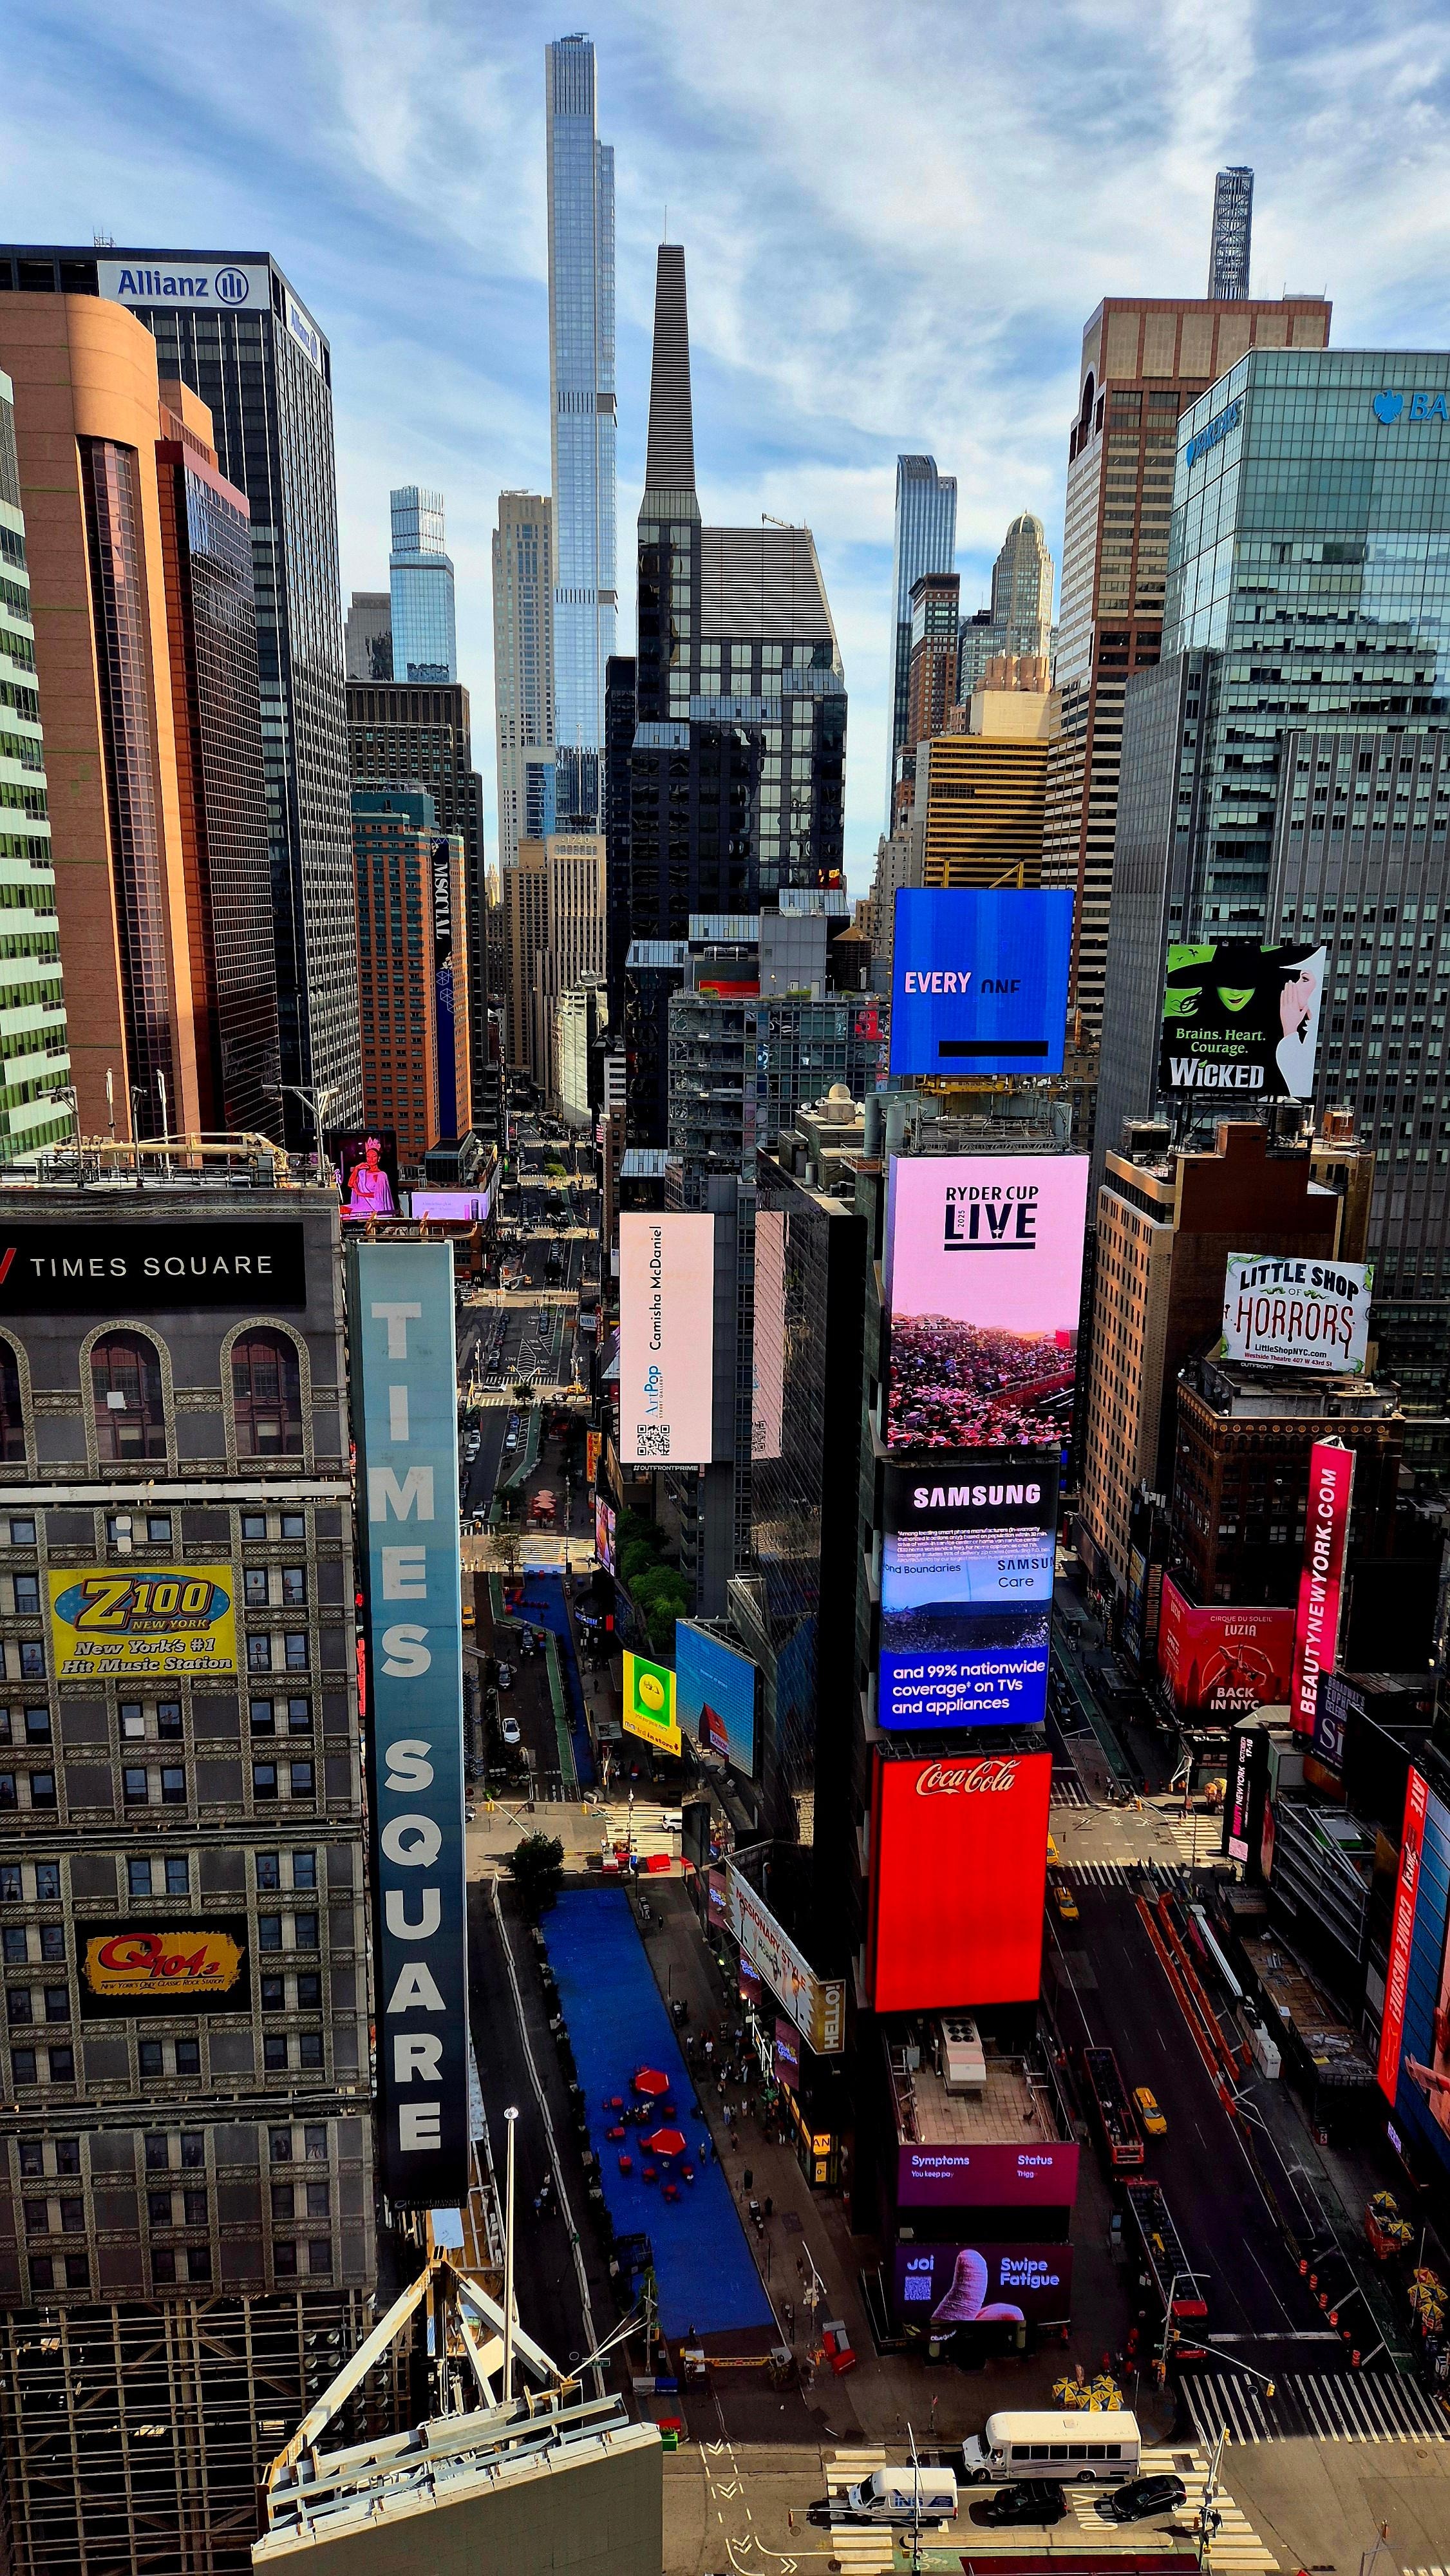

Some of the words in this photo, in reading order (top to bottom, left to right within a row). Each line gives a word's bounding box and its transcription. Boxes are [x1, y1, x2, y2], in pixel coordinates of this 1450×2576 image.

[118, 270, 209, 298] Allianz
[291, 305, 310, 350] Allianz
[905, 971, 972, 993] EVERY
[1176, 1028, 1221, 1040] Brains.
[1225, 1029, 1266, 1041] Heart.
[1191, 1041, 1248, 1056] Courage.
[946, 1186, 1002, 1201] RYDER
[1006, 1186, 1039, 1200] CUP
[944, 1203, 1038, 1240] LIVE
[957, 1209, 966, 1228] 2025
[30, 1258, 127, 1277] TIMES
[143, 1256, 273, 1276] SQUARE
[649, 1226, 662, 1289] McDaniel
[1239, 1262, 1306, 1291] LITTLE
[1310, 1265, 1359, 1302] SHOP
[1288, 1288, 1302, 1296] OF
[649, 1293, 662, 1351] Camisha
[1236, 1296, 1354, 1359] HORRORS
[1244, 1352, 1269, 1360] Westside
[1270, 1354, 1291, 1363] Theatre
[1255, 1343, 1327, 1359] LittleShopNYC.com
[645, 1365, 659, 1417] ArtPop
[368, 1302, 435, 1678] TIMES
[914, 1484, 1041, 1508] SAMSUNG
[884, 1564, 901, 1575] ond
[904, 1563, 961, 1574] Boundaries
[999, 1577, 1034, 1587] Care
[1147, 1564, 1162, 1598] PATRICIA
[1300, 1468, 1337, 1716] BEAUTYNEWYORK.COM
[74, 1578, 214, 1629] Z100
[132, 1621, 169, 1631] NEW
[169, 1618, 209, 1629] YORK
[1145, 1599, 1160, 1638] CORNWELL
[1225, 1625, 1257, 1637] LUZIA
[75, 1642, 124, 1656] New
[128, 1638, 186, 1654] York's
[191, 1637, 216, 1652] #1
[61, 1660, 95, 1674] Hit
[98, 1657, 160, 1672] Music
[164, 1656, 232, 1671] Station
[893, 1666, 924, 1679] and
[928, 1664, 957, 1678] 99%
[961, 1660, 1045, 1676] nationwide
[974, 1682, 993, 1692] on
[997, 1678, 1023, 1691] TVs
[1216, 1687, 1255, 1698] BACK
[892, 1700, 923, 1714] and
[926, 1697, 1010, 1716] appliances
[1210, 1699, 1228, 1710] IN
[1230, 1699, 1259, 1710] NYC
[1320, 1718, 1345, 1757] SI
[916, 1760, 1022, 1796] Coca-Cola
[735, 1886, 780, 1953] MISSIONARY
[381, 1739, 446, 2152] SQUARE
[1389, 1949, 1407, 2025] INSIDE!
[824, 1984, 842, 2050] HELLO!
[912, 2155, 970, 2167] Symptoms
[1018, 2155, 1053, 2165] Status
[925, 2170, 941, 2179] keep
[907, 2255, 934, 2270] Joi
[1001, 2257, 1048, 2273] Swipe
[1001, 2273, 1060, 2289] Fatigue
